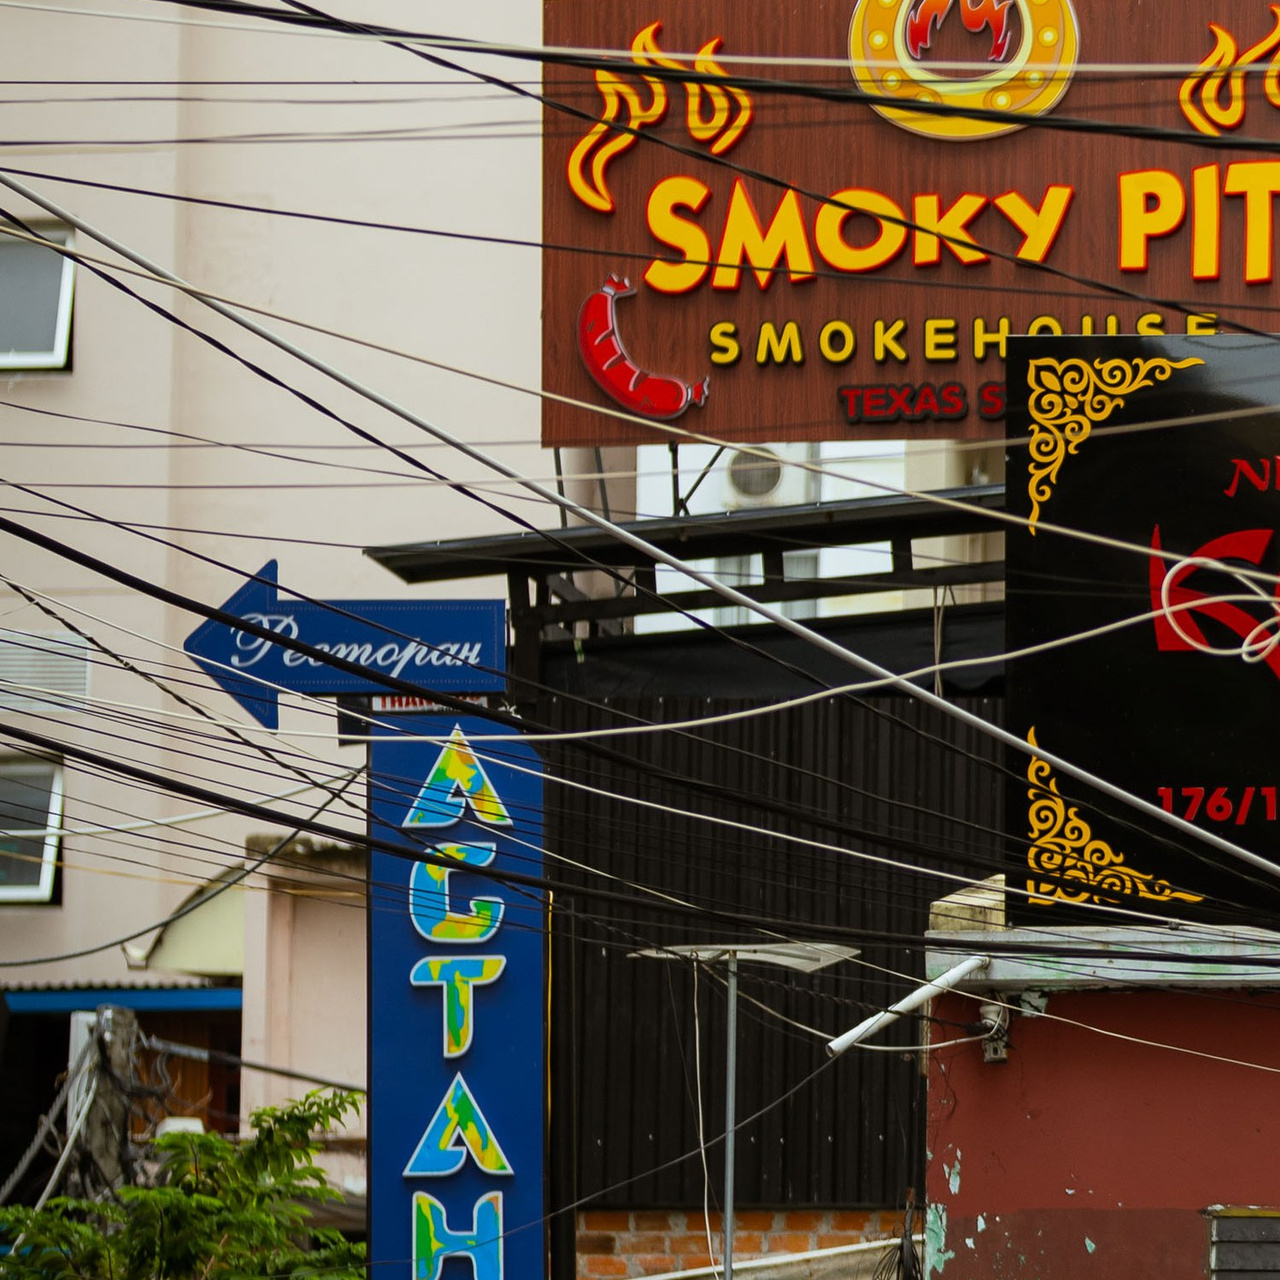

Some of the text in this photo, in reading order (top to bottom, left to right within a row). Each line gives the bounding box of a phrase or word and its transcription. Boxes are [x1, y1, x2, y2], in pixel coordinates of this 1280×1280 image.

[643, 174, 1076, 294] SMOKY
[841, 384, 1006, 417] TEXAS S
[230, 612, 482, 678] Ресторан
